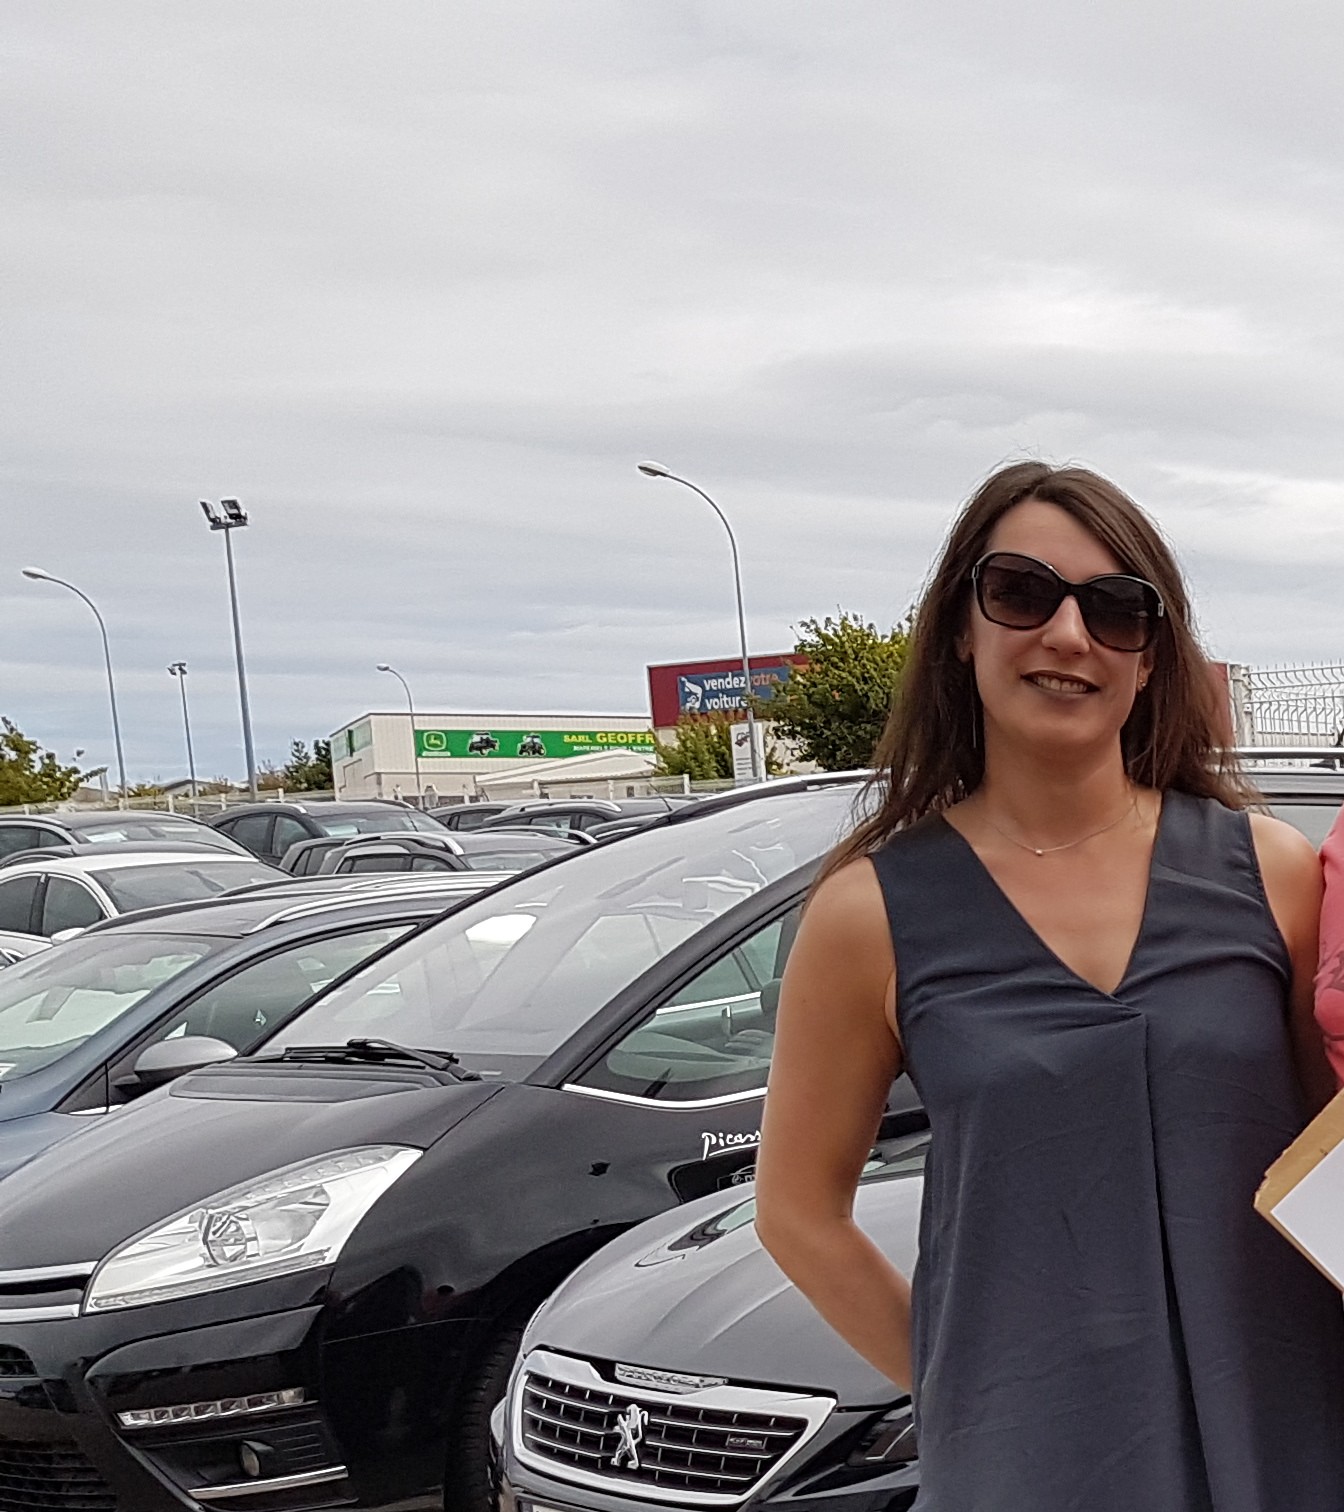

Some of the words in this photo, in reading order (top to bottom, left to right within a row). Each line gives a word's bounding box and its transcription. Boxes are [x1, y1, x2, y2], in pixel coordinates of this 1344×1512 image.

[703, 672, 746, 690] vendez
[563, 734, 593, 744] SARL
[596, 732, 655, 744] GEOFFR
[702, 1130, 762, 1160] Picass
